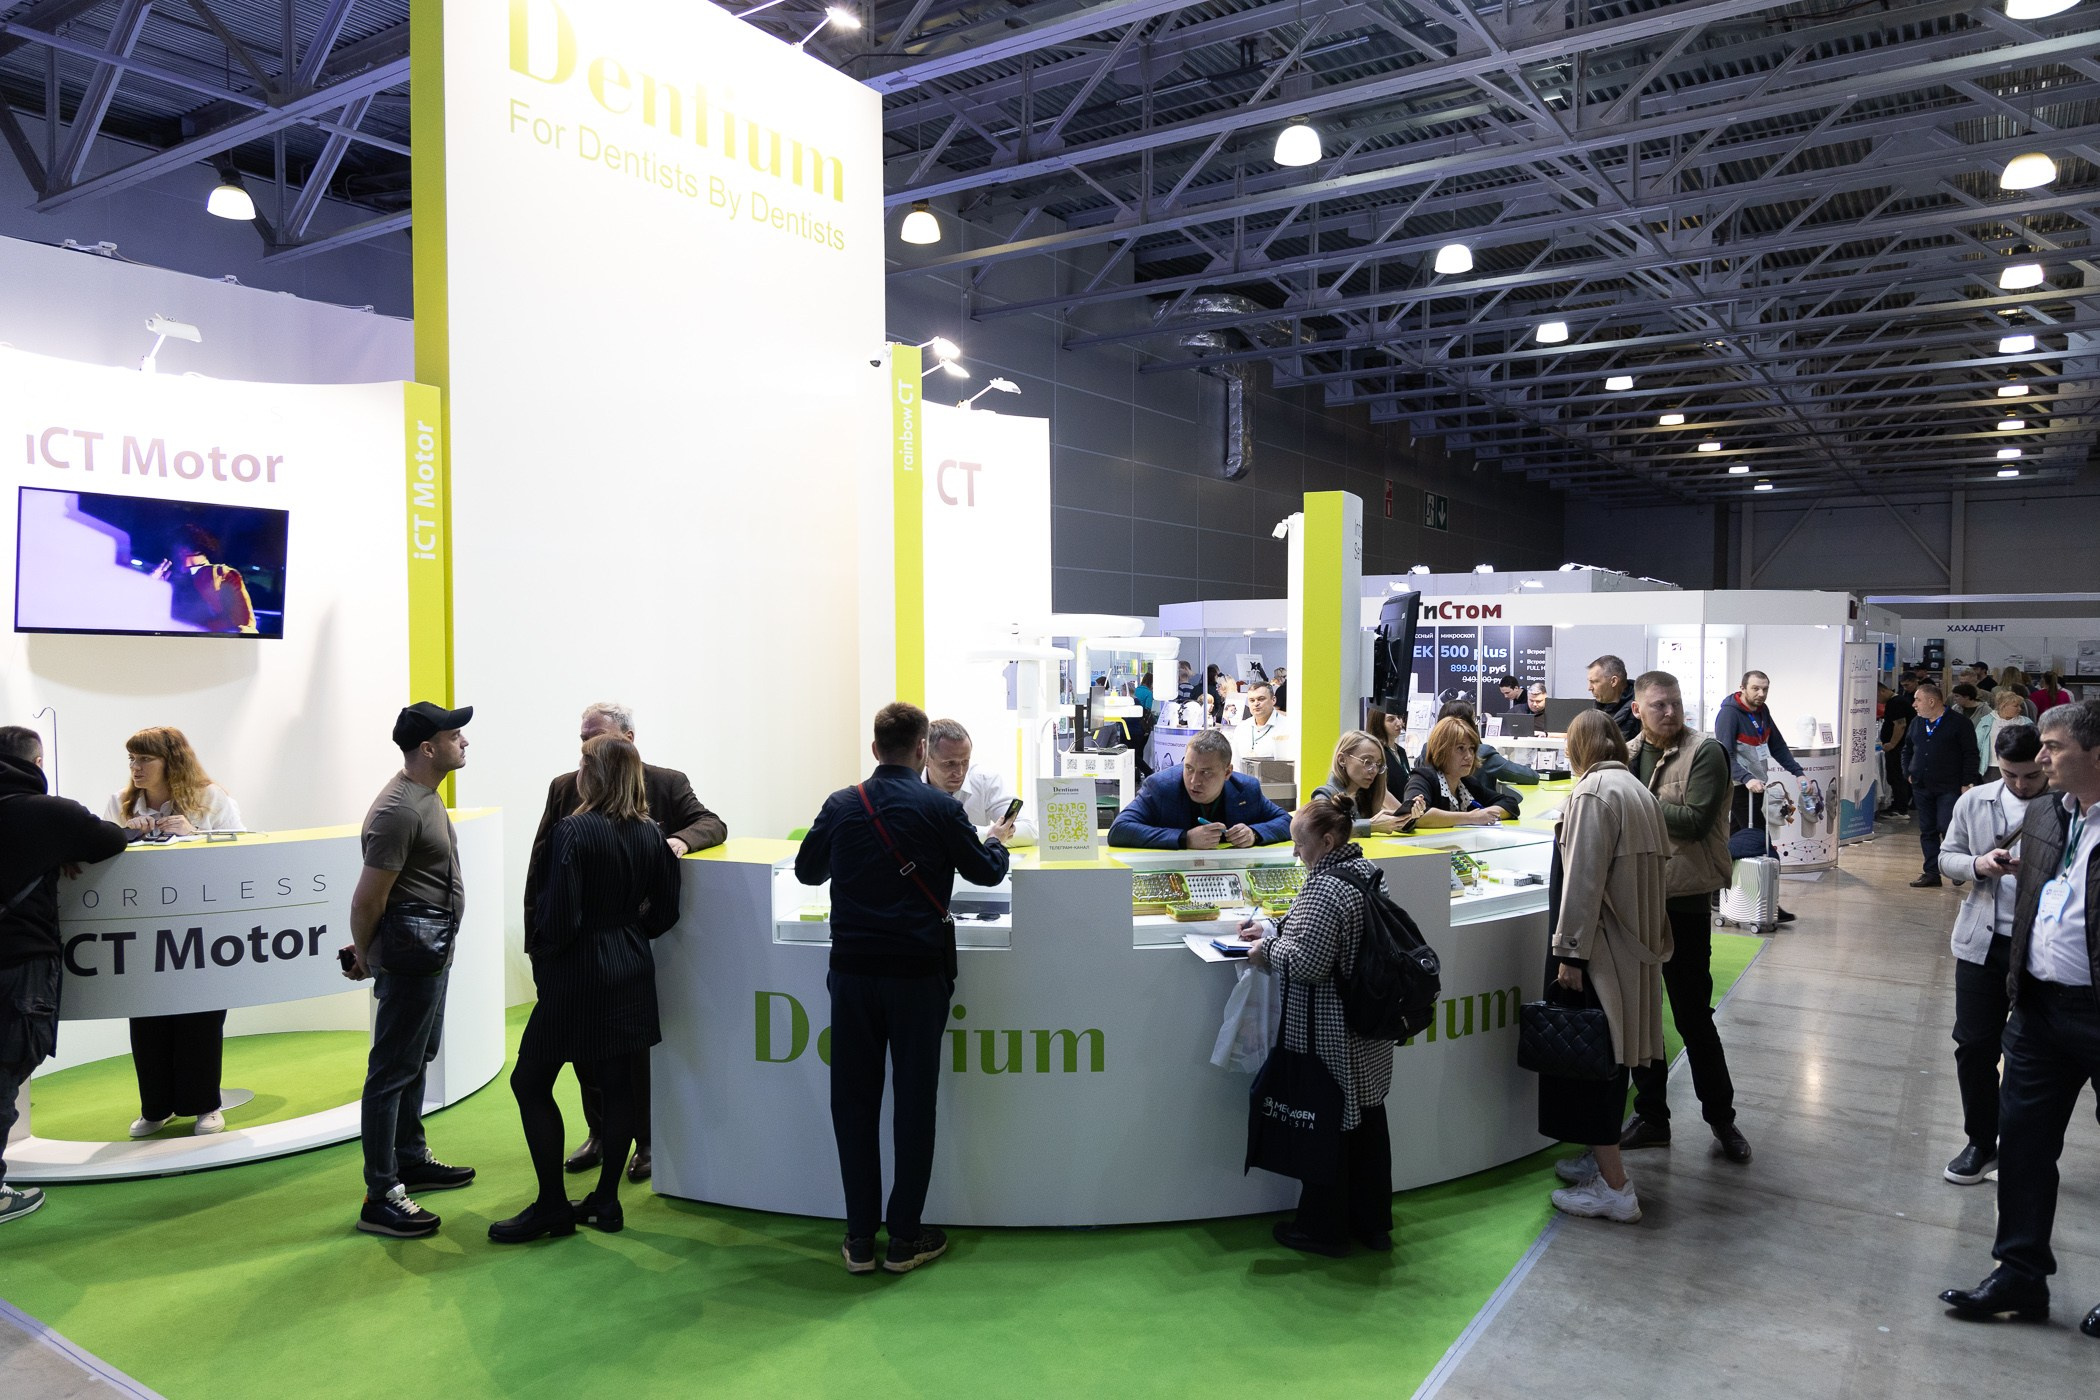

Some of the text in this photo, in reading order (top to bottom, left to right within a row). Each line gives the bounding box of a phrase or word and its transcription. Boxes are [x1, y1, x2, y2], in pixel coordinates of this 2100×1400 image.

[509, 0, 844, 203] Dentium
[510, 97, 845, 250] For Dentists By Dentists
[898, 379, 914, 471] rainbow CT
[26, 426, 284, 483] iCT Motor
[413, 420, 436, 560] iCT Motor
[937, 459, 982, 507] CT
[1412, 645, 1508, 661] EK 500 plus
[1947, 624, 2006, 633] ХАХАДЕНТ
[1462, 675, 1492, 683] 949.00
[1489, 664, 1507, 675] руб
[57, 874, 327, 909] ORDLESS
[62, 924, 327, 977] CT Motor
[755, 990, 1105, 1075] Dium
[1272, 1110, 1315, 1130] RUSIA
